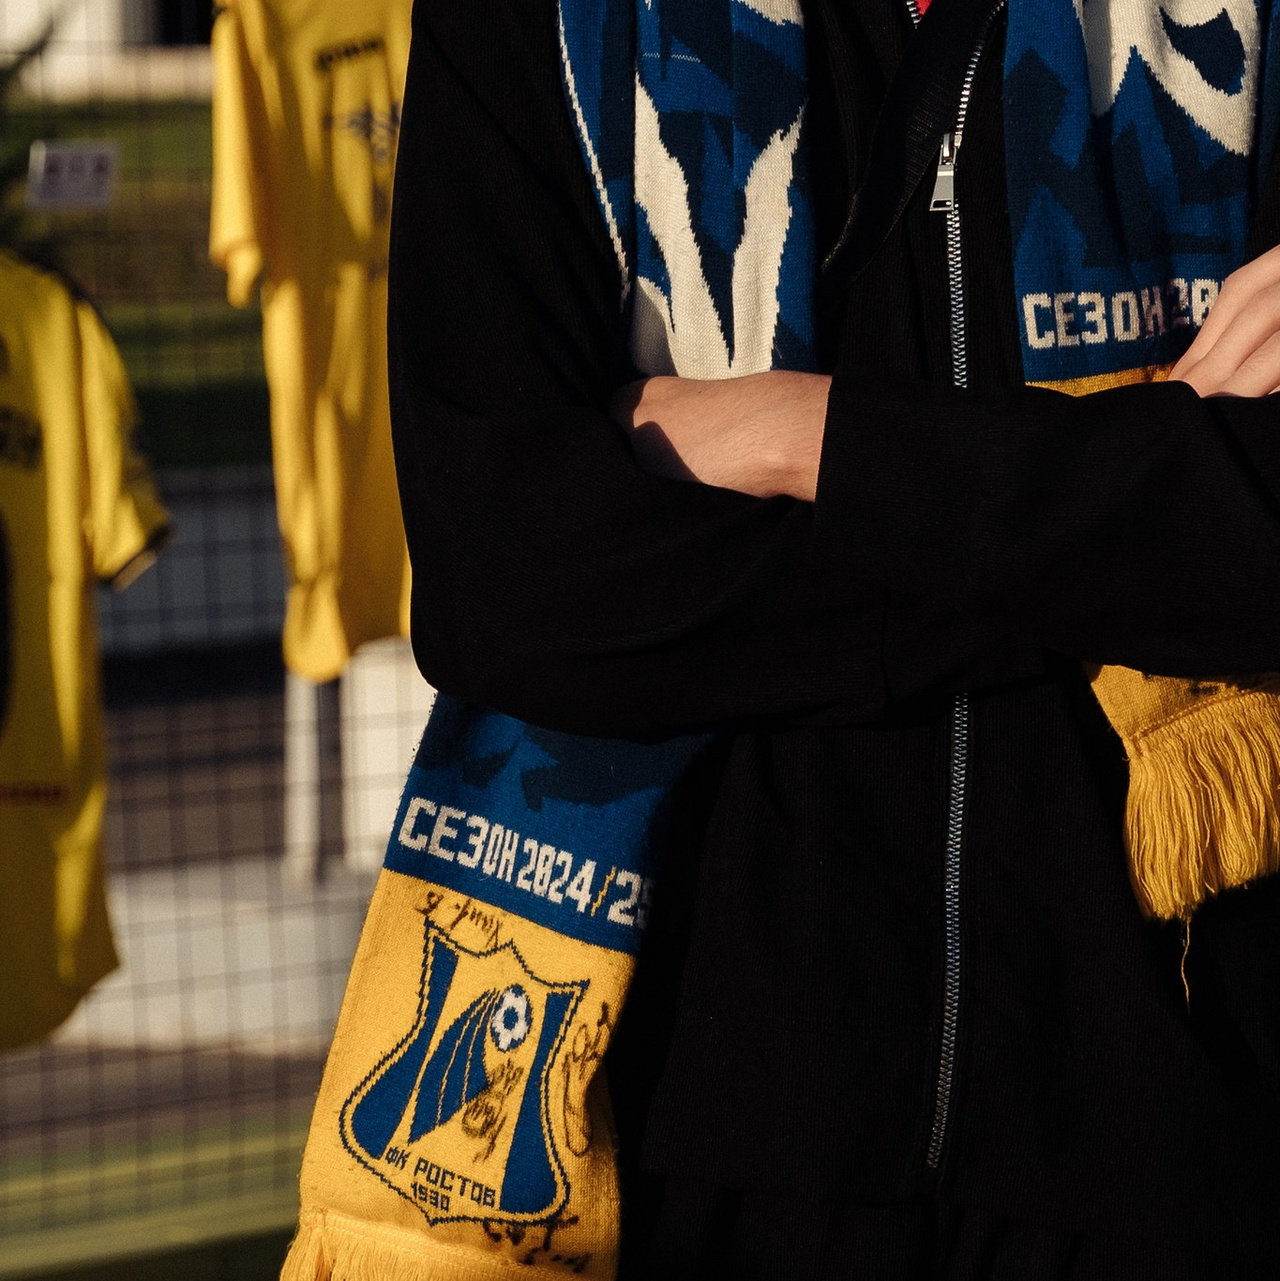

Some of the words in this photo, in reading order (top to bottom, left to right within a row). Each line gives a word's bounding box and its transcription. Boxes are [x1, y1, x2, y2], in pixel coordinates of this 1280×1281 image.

[1022, 286, 1167, 350] СЕЗОН
[398, 797, 520, 883] СЕЗОН
[385, 1146, 411, 1170] ФК
[413, 1156, 496, 1208] РОСТОВ
[410, 1181, 450, 1213] 1930
